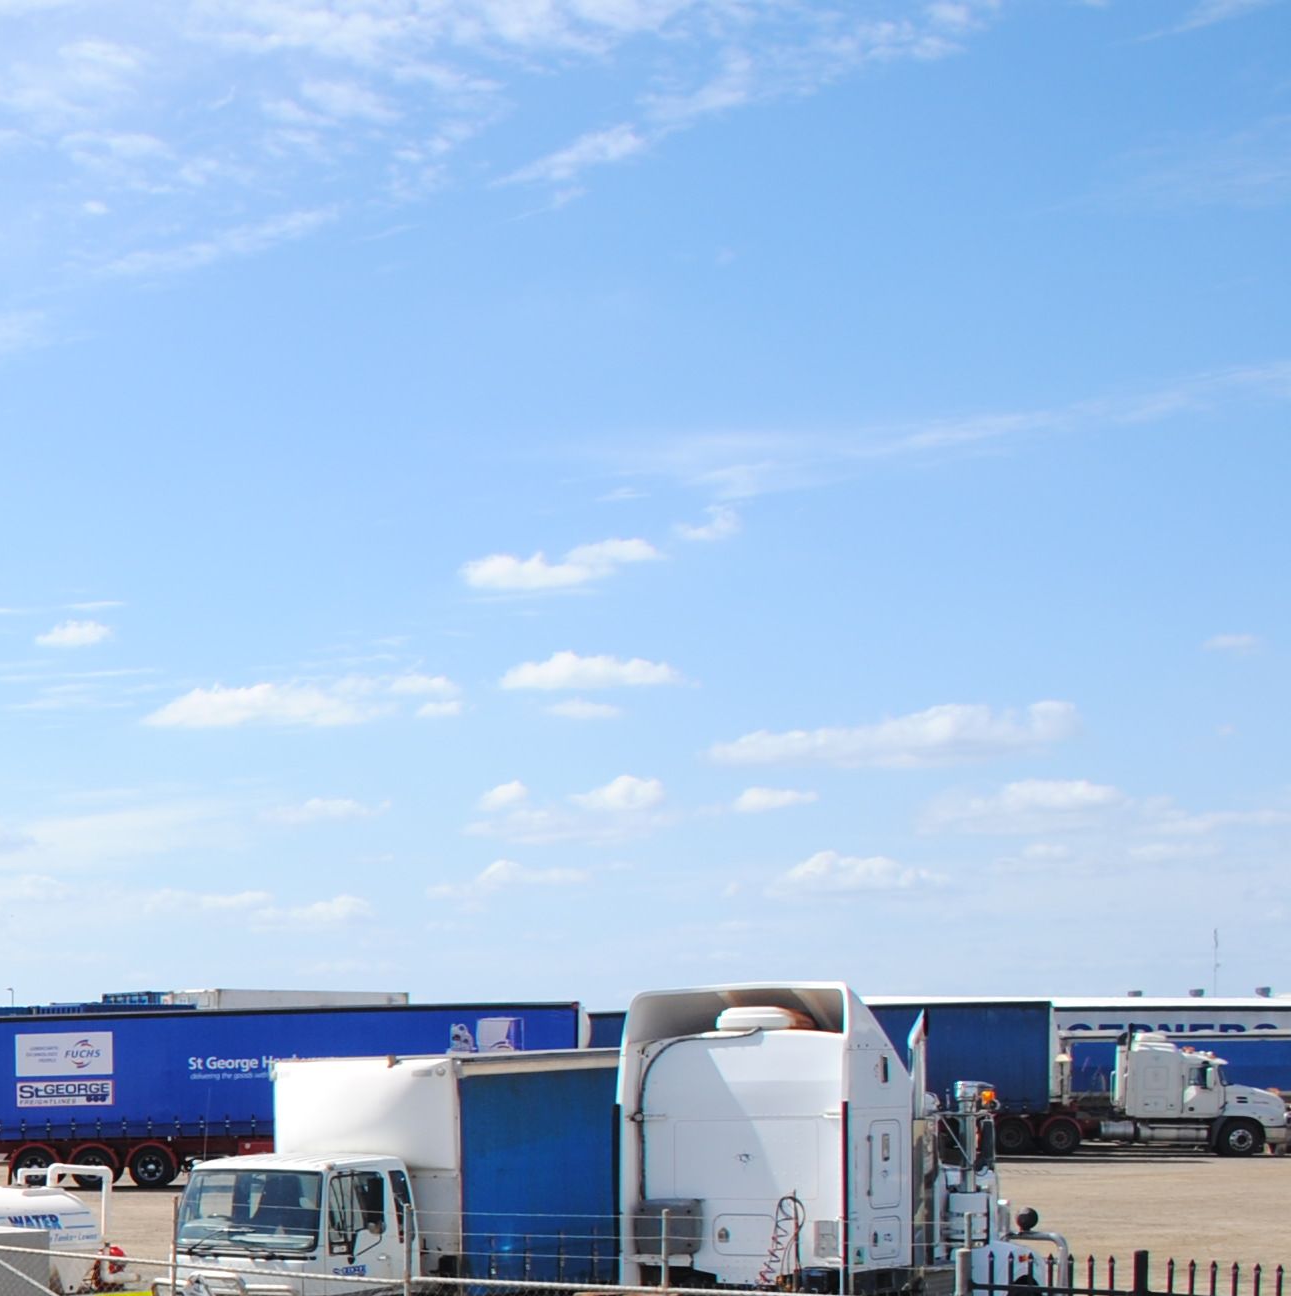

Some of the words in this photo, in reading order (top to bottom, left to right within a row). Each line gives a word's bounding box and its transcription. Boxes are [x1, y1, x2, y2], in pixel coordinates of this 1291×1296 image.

[64, 1049, 101, 1058] FUCHS
[187, 1057, 203, 1069] St
[206, 1056, 258, 1072] George
[222, 1072, 232, 1080] the
[234, 1072, 254, 1081] goods
[19, 1084, 44, 1099] St
[43, 1082, 110, 1095] GEORGE
[7, 1214, 63, 1229] WATER
